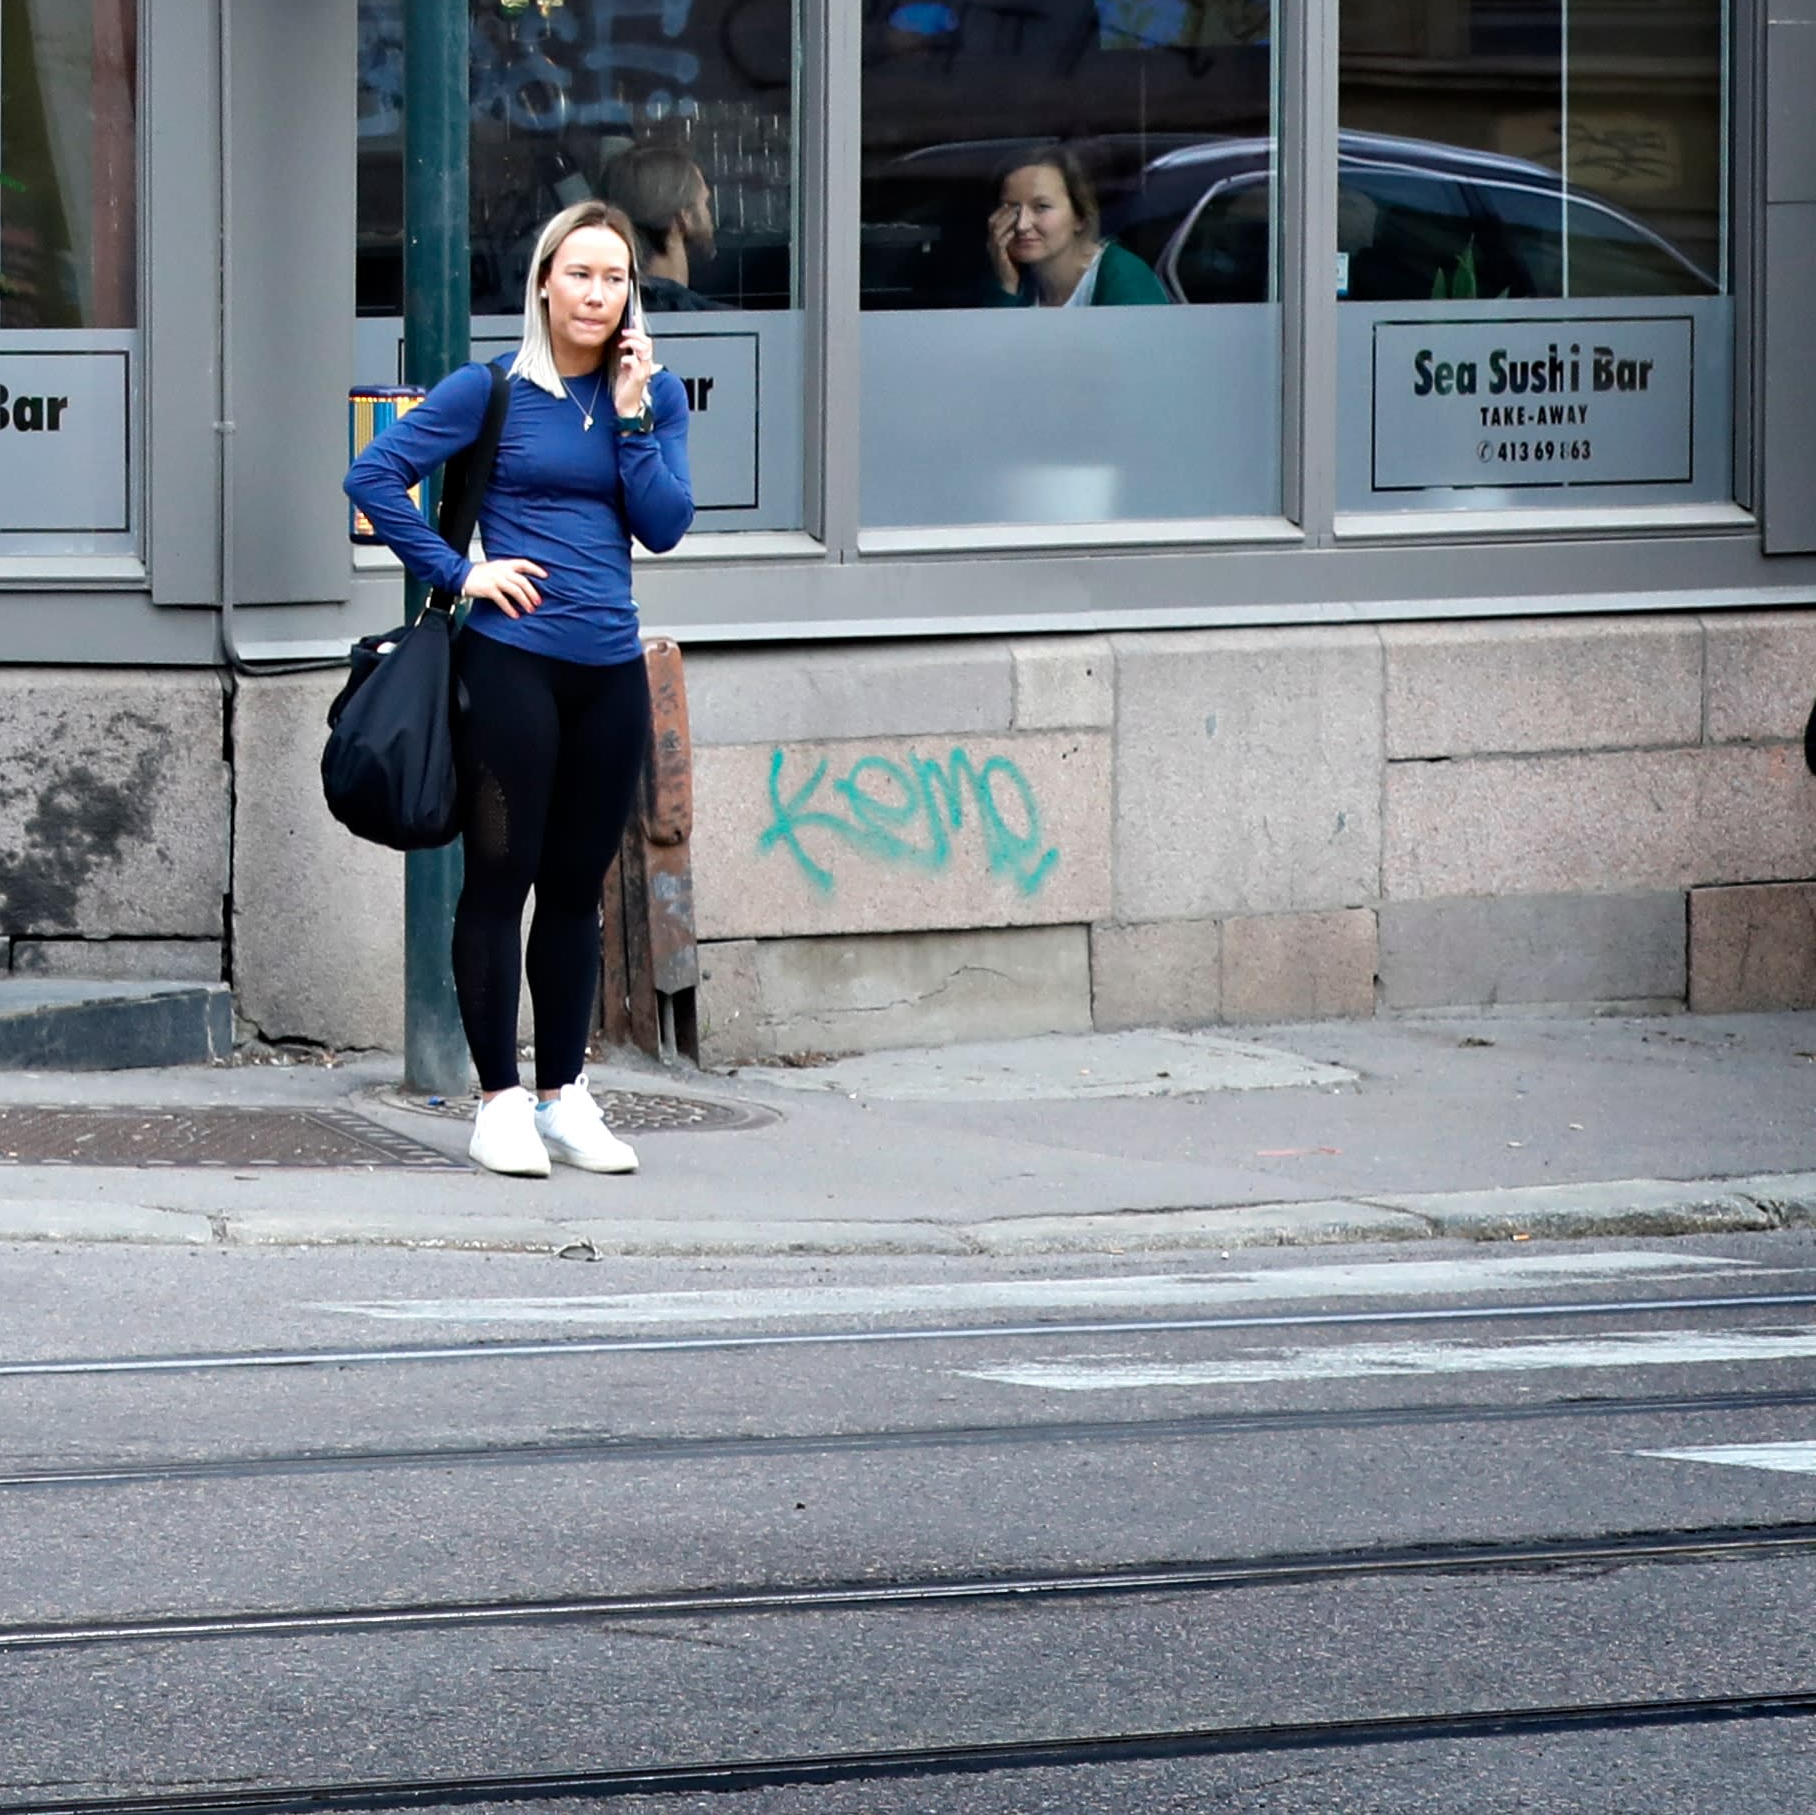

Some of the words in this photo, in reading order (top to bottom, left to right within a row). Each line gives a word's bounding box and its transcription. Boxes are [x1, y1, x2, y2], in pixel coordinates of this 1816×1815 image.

[1414, 349, 1477, 397] Sea
[1489, 344, 1581, 395] Sushi
[1592, 346, 1655, 393] Bar
[1480, 404, 1589, 427] TAKE-AWAY
[1497, 441, 1529, 463] 413
[1534, 440, 1555, 462] 69
